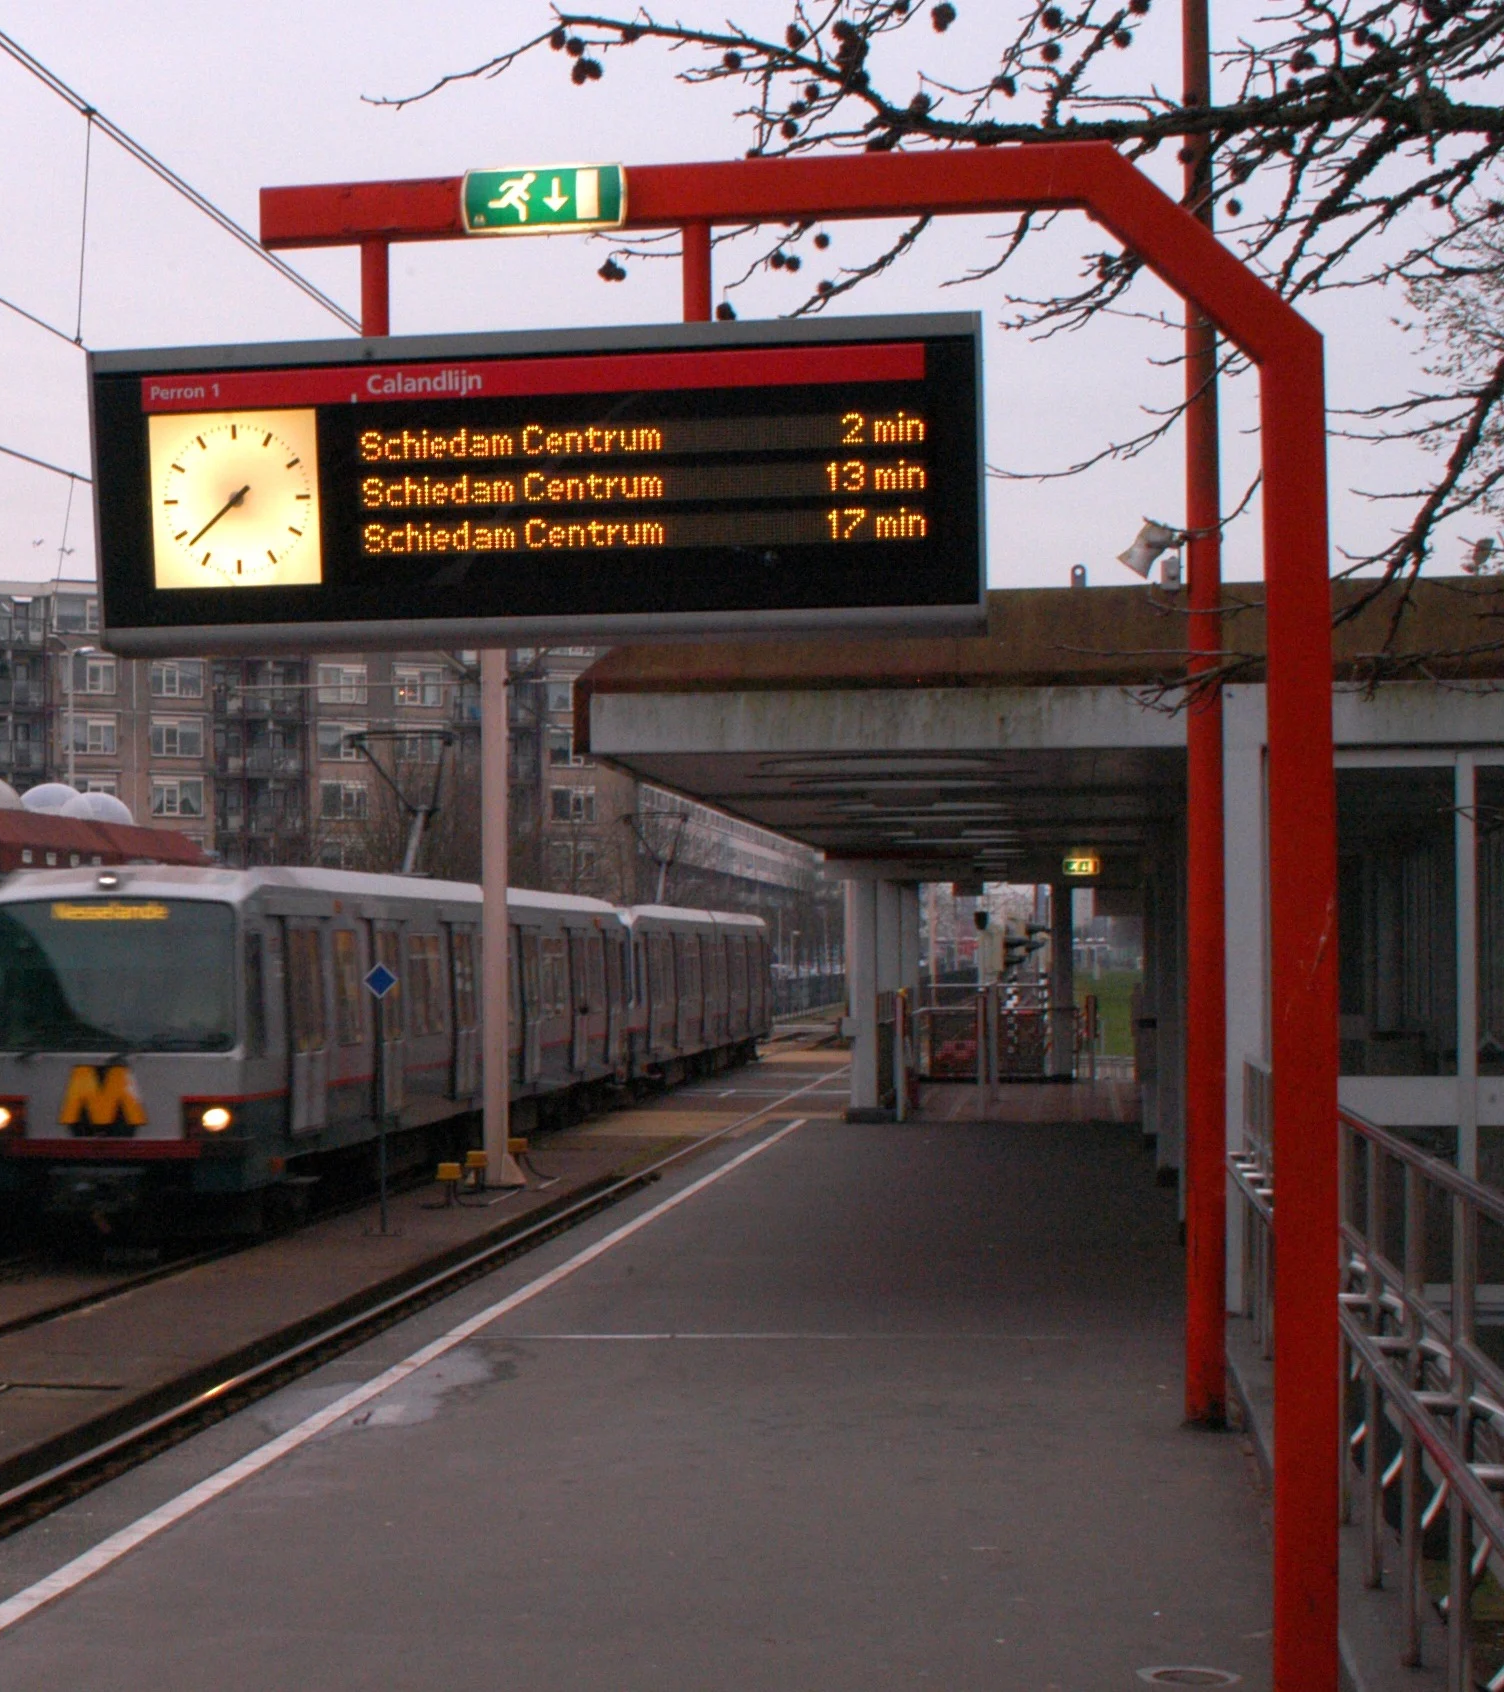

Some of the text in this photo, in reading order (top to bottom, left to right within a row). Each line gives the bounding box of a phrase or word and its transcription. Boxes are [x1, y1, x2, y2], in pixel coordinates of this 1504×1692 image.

[149, 384, 220, 401] Perron 1
[366, 370, 483, 396] Calandlijn
[361, 411, 924, 461] Schiedam Centrum 2 min
[362, 459, 925, 507] Schiedam Centrum 13 min
[364, 506, 926, 553] Schiedam Centrum 17 min
[59, 1065, 148, 1125] M
